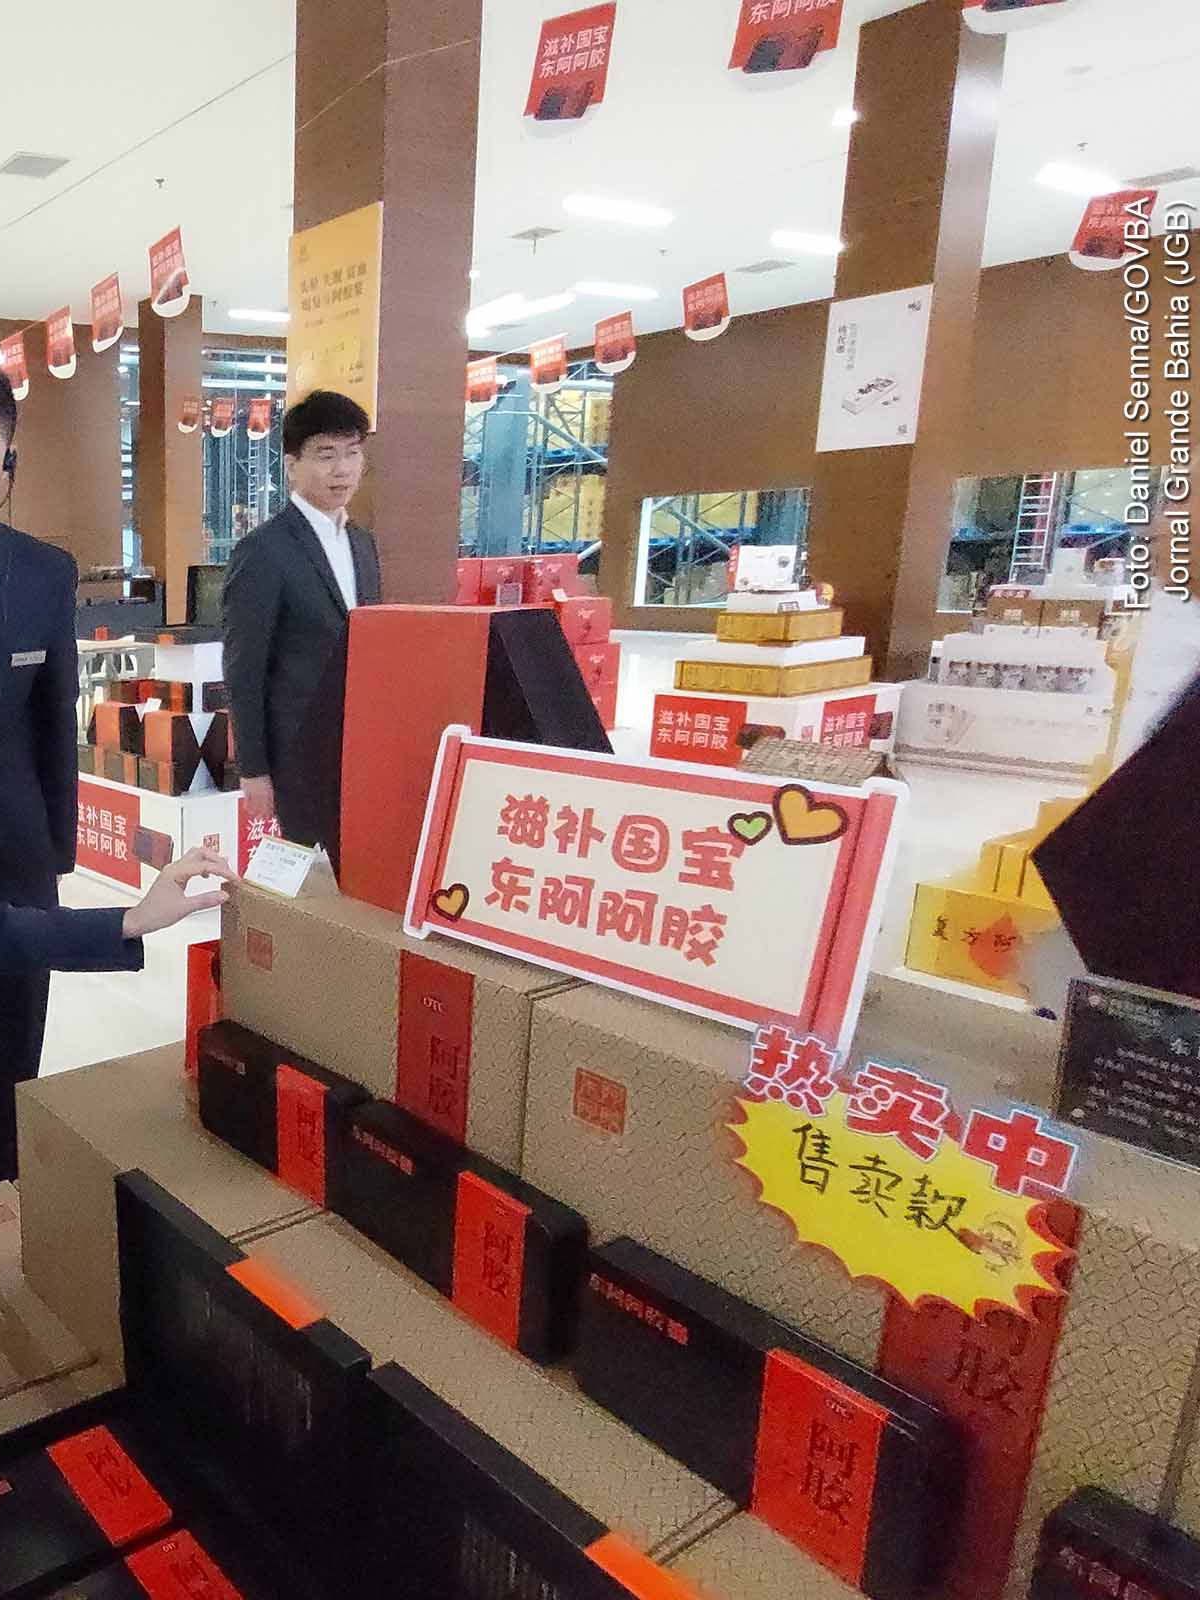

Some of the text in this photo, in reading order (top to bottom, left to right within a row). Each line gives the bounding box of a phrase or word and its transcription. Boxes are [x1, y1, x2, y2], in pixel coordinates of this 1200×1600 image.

[539, 48, 606, 78] 东阿阿胶
[542, 26, 608, 57] 滋补国宝
[656, 728, 728, 751] 东阿阿胶
[657, 710, 730, 732] 滋补国宝
[497, 793, 748, 891] 滋补国宝
[484, 857, 728, 967] 东阿阿胶
[744, 1025, 1079, 1198] 热卖中
[792, 1123, 974, 1250] 售卖款
[800, 1419, 860, 1526] 阿胶
